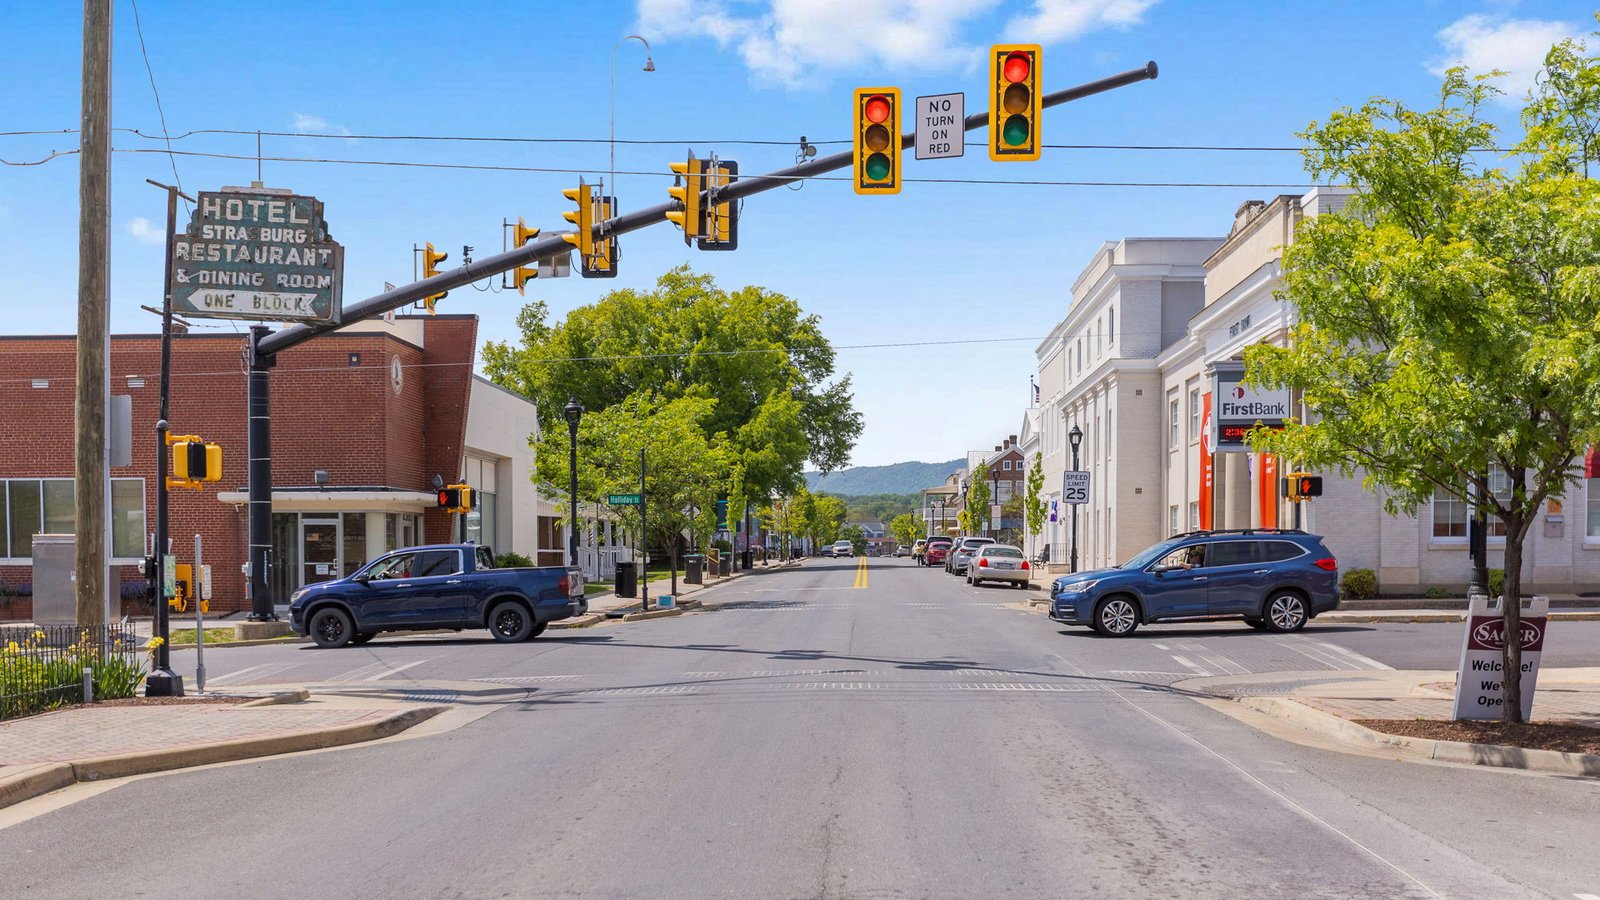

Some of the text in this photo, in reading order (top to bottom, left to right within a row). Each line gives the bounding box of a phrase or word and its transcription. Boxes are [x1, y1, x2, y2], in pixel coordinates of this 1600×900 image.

[929, 99, 951, 113] NO
[926, 115, 954, 127] TURN
[932, 130, 948, 140] ON
[929, 143, 950, 154] RED
[203, 197, 309, 224] HOTEL
[176, 242, 331, 266] RESTAURANT
[176, 268, 331, 289] & DINING ROOM
[204, 294, 303, 312] ONE BLOCK
[1222, 402, 1285, 416] FirstBank
[610, 495, 633, 504] Holliday
[1066, 487, 1086, 500] 25
[1477, 624, 1535, 642] SAR
[1472, 659, 1533, 672] Welce!
[1477, 695, 1503, 708] Ope
